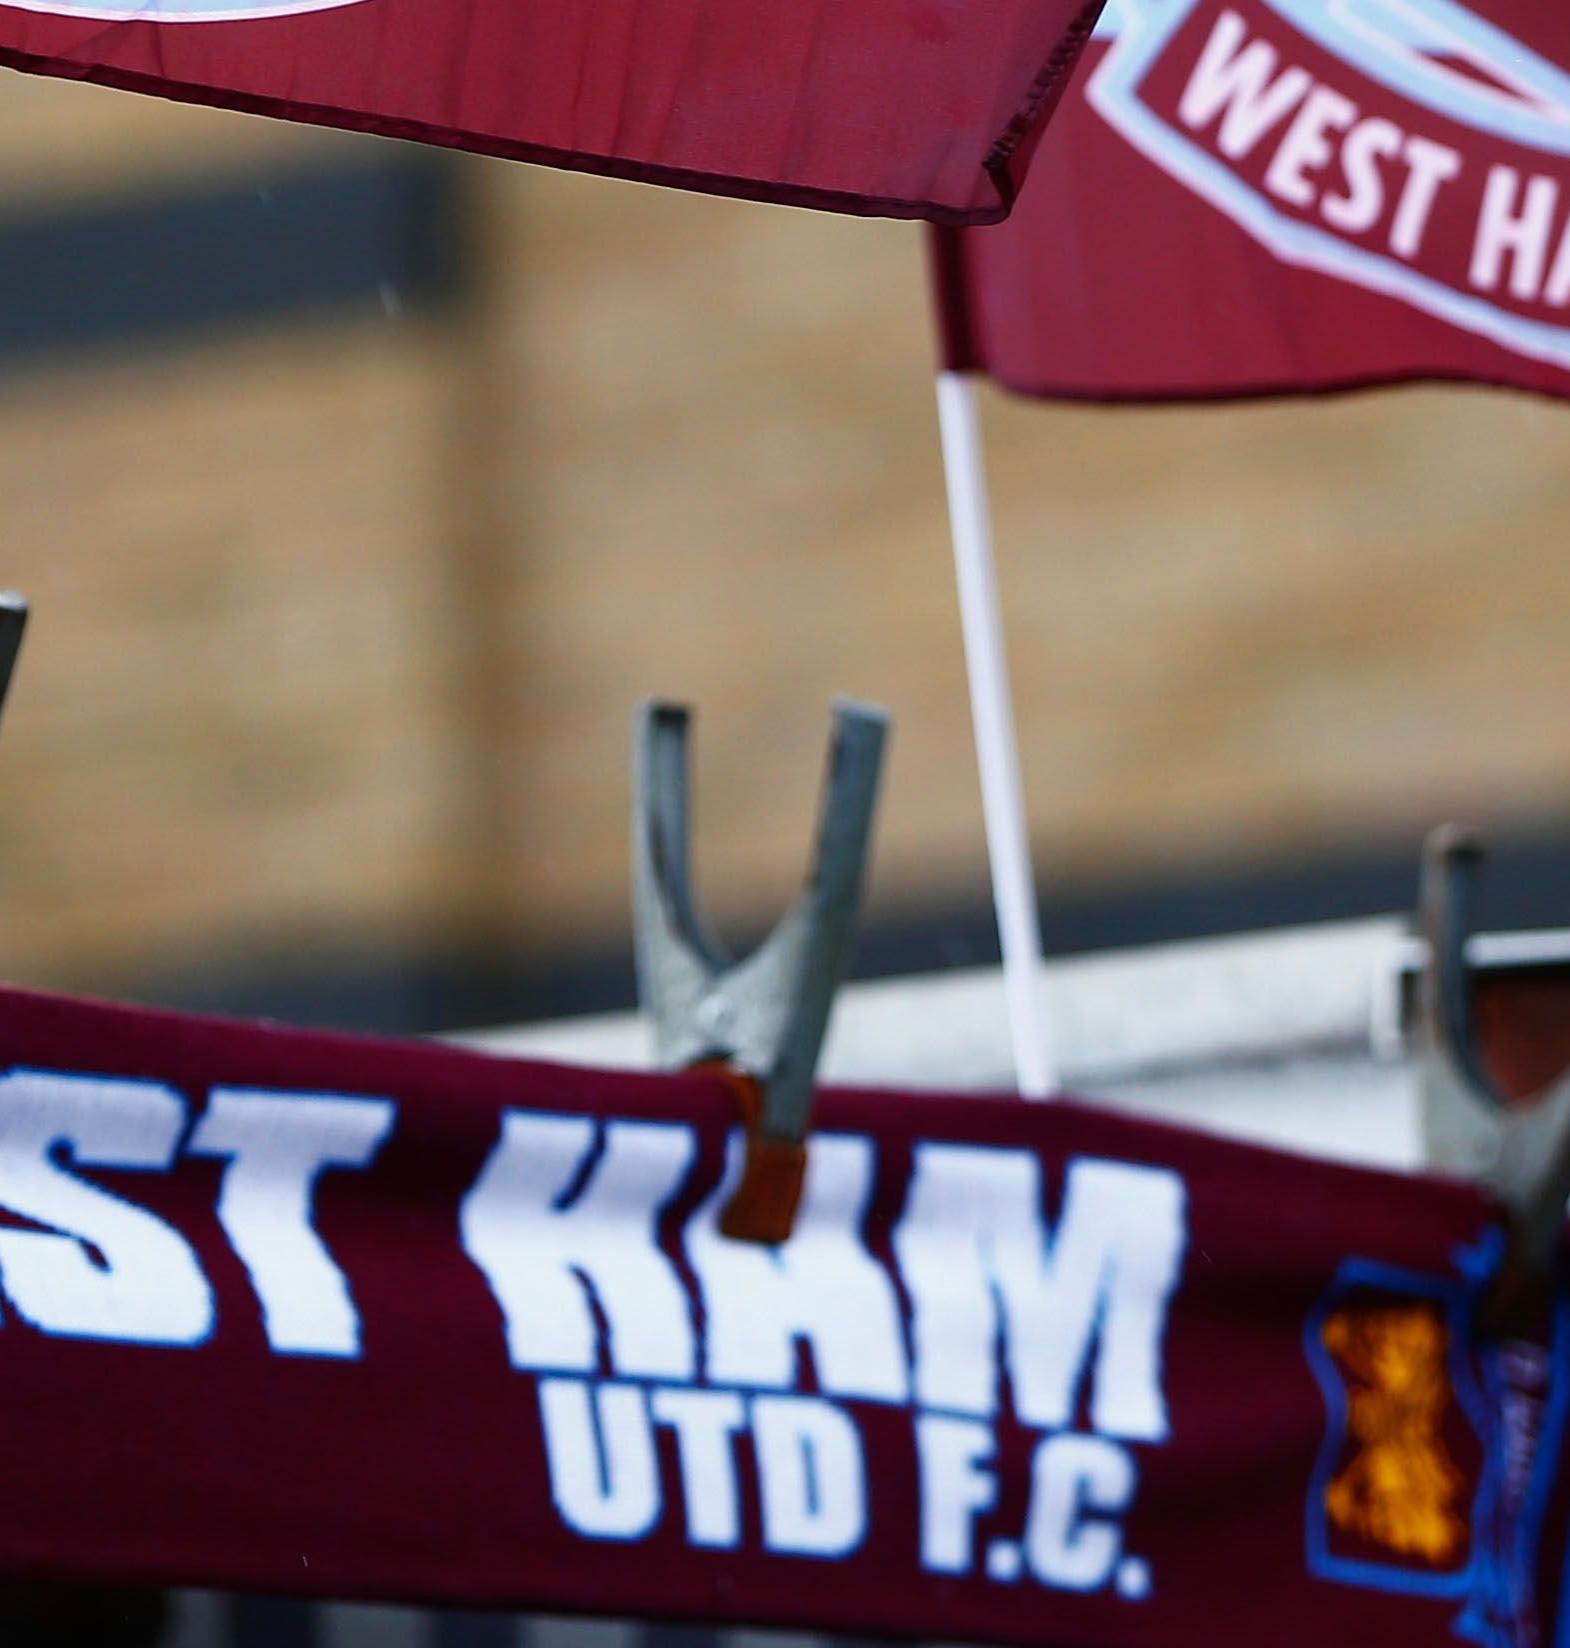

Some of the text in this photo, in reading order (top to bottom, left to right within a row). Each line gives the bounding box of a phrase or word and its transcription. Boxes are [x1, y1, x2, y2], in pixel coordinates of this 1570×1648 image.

[1177, 9, 1461, 258] WEST
[457, 1108, 1187, 1444] HAM
[535, 1374, 1151, 1599] UTD F.C.
